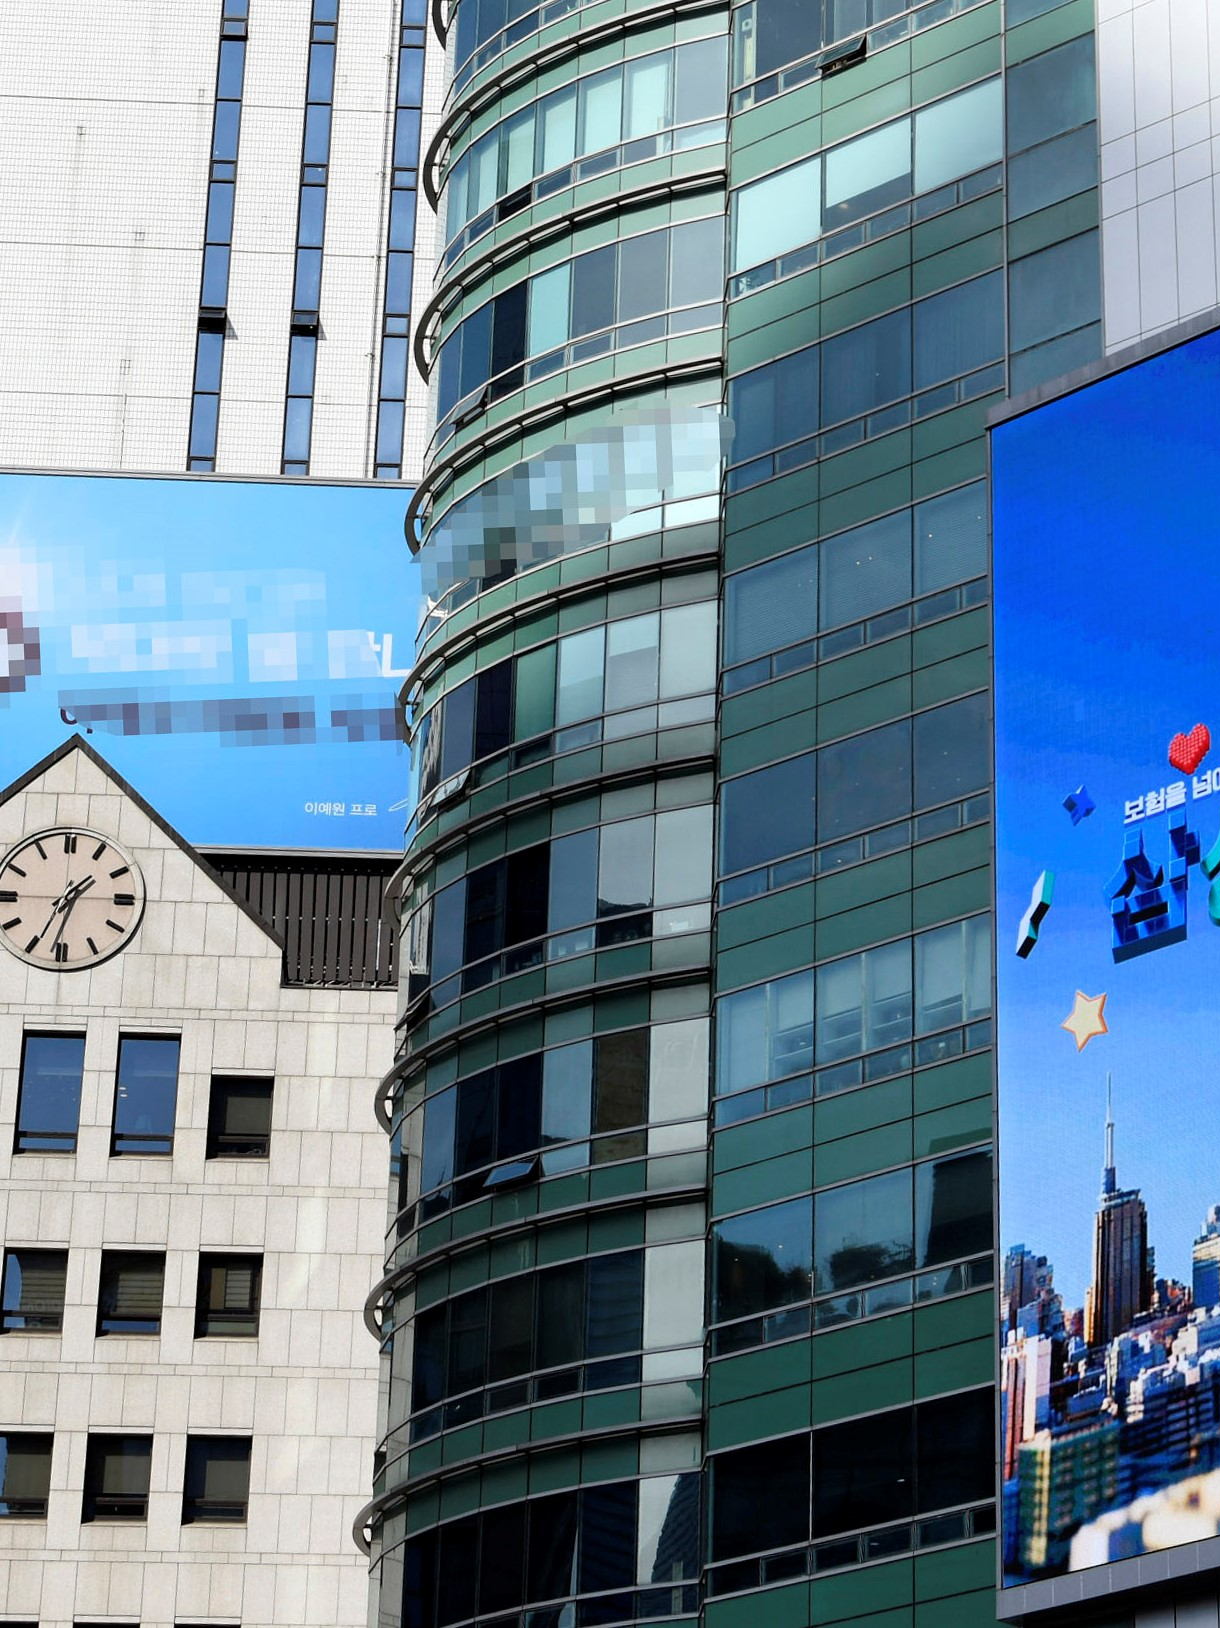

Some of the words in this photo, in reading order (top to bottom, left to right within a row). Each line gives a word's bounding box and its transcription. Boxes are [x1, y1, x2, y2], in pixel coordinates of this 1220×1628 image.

[304, 802, 345, 816] 이예원
[350, 804, 378, 816] 프로
[1123, 780, 1187, 824] 보험을
